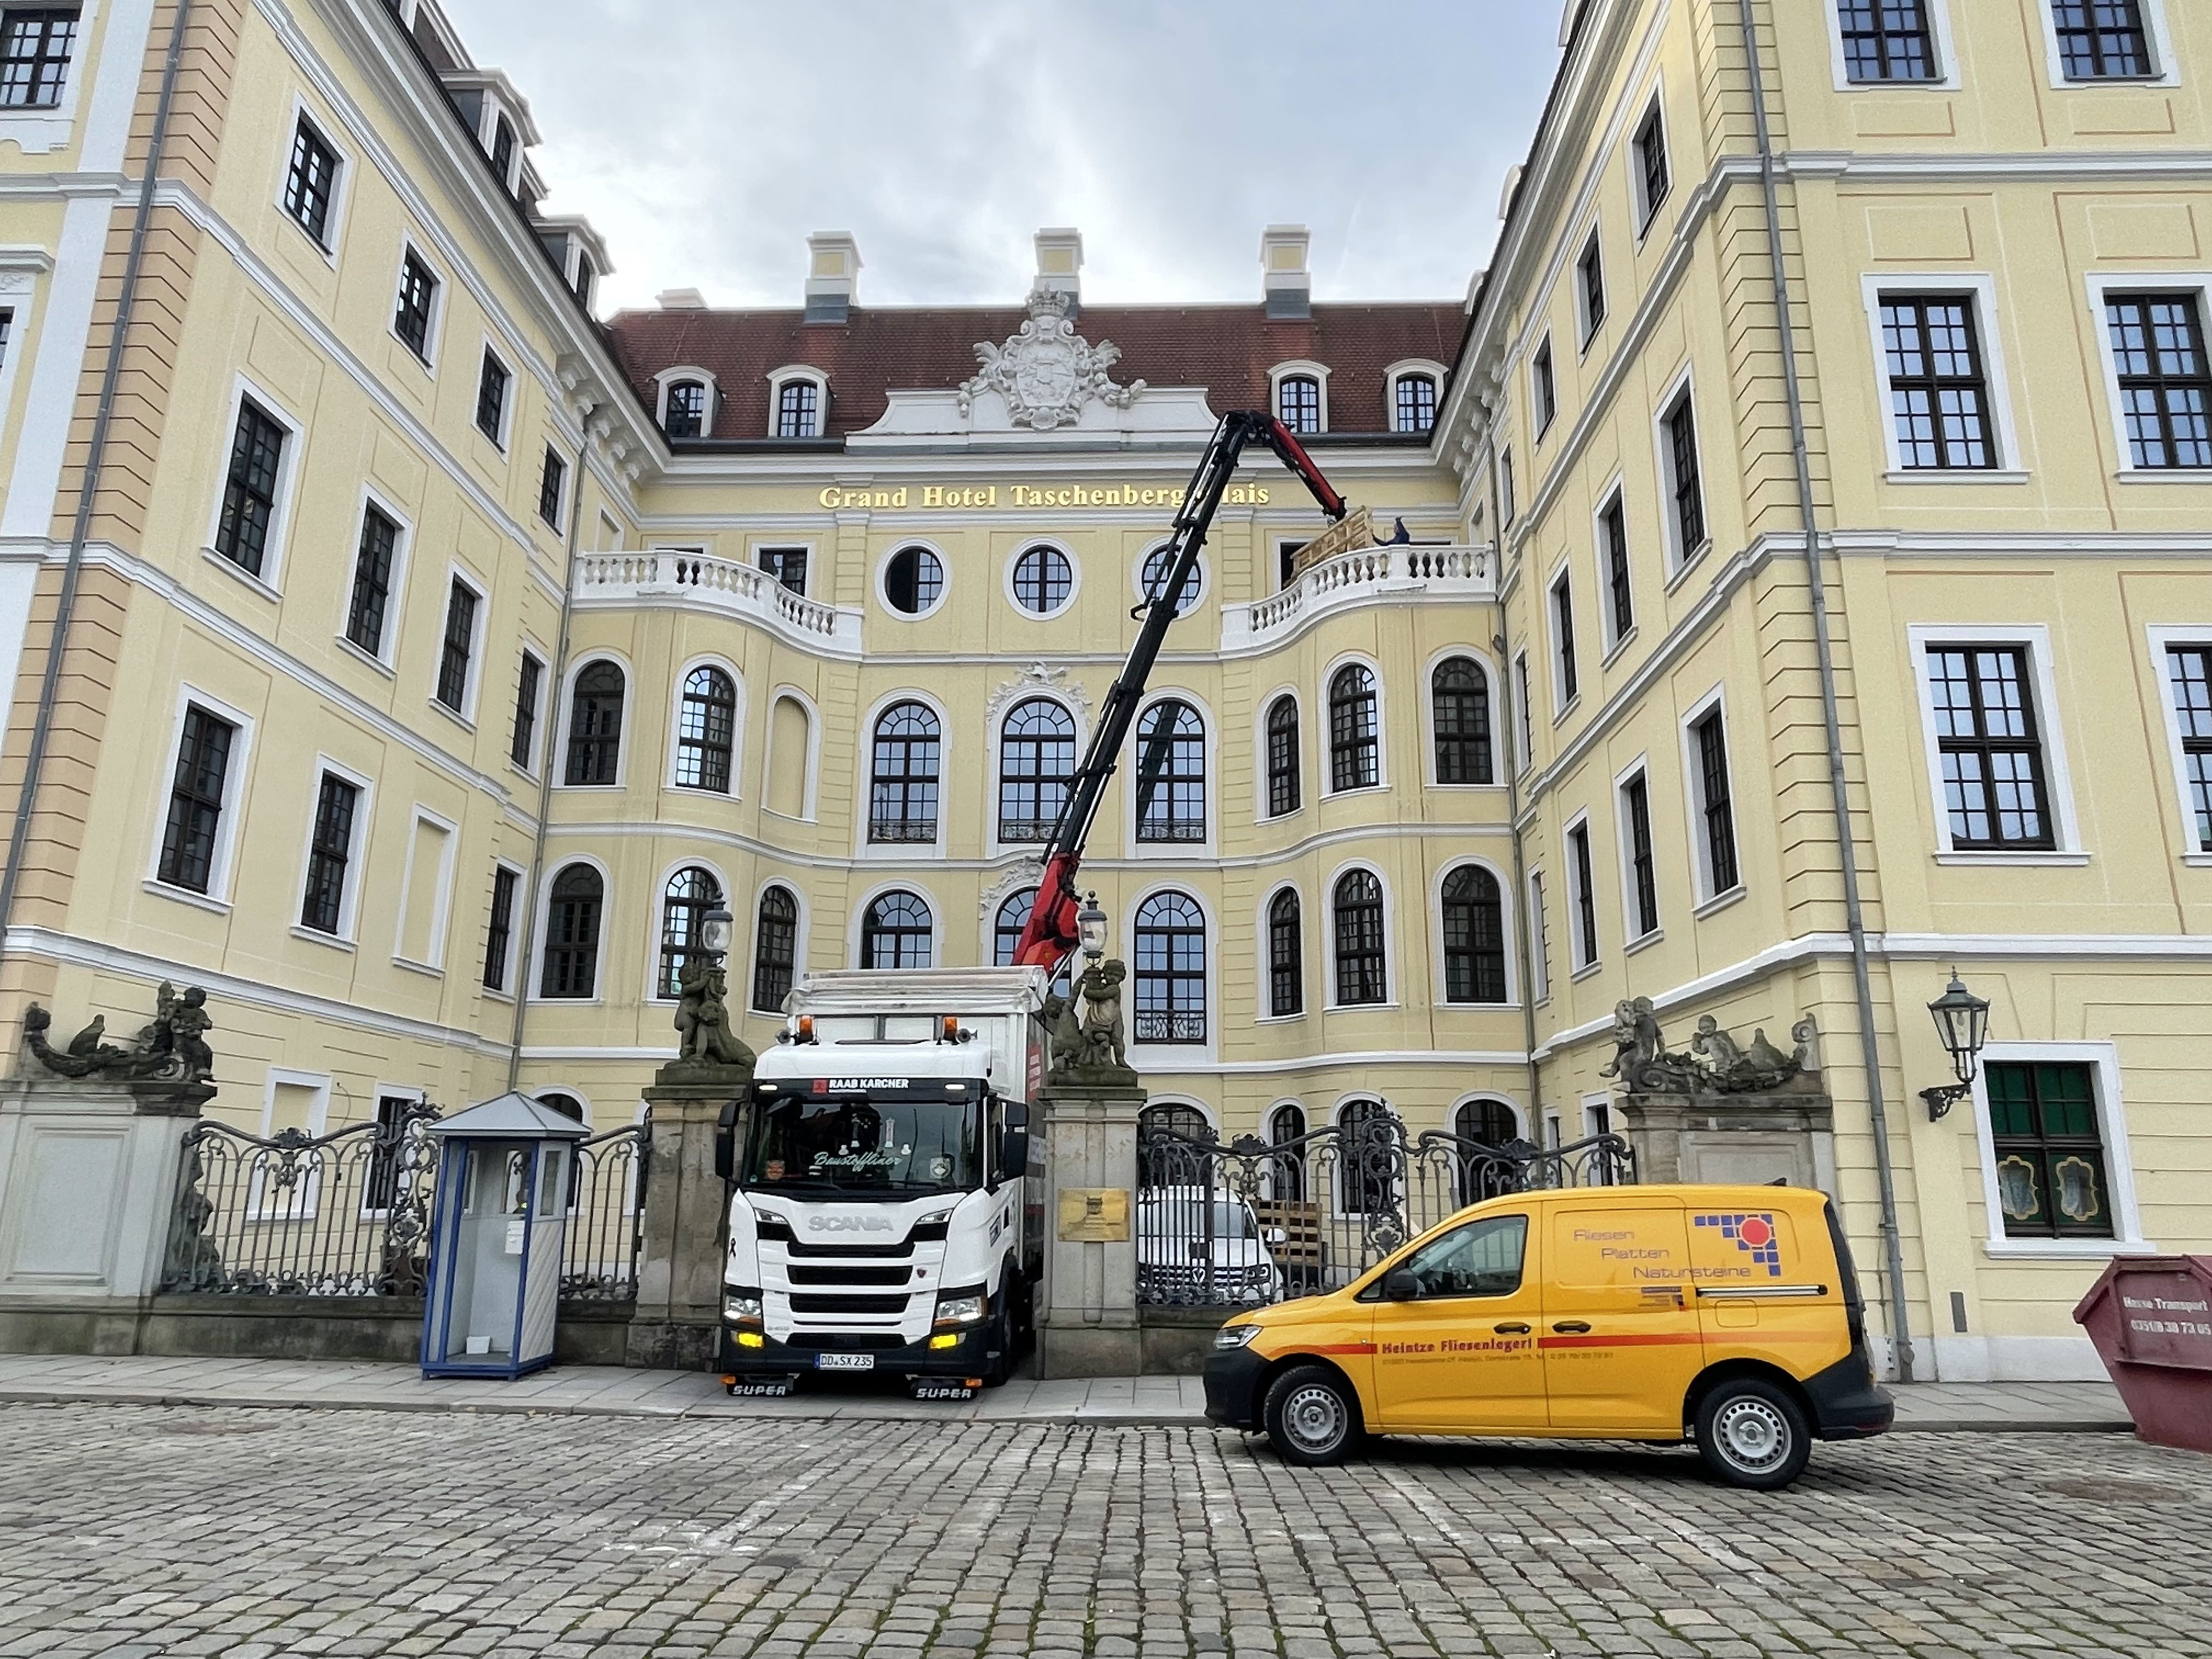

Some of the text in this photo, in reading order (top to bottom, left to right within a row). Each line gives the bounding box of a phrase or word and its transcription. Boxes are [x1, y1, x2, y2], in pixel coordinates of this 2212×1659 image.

[820, 483, 1269, 508] Grand Hotel Taschenberglais
[829, 1079, 910, 1088] RAAB KARCHER
[809, 1216, 894, 1232] SCANIA
[1573, 1229, 1635, 1241] Fliesen
[1601, 1248, 1670, 1260] Platten
[1633, 1266, 1751, 1279] Natursteine
[1382, 1342, 1435, 1354] Heintze
[821, 1355, 872, 1366] DD SX 235
[732, 1385, 786, 1396] SUPER
[916, 1388, 971, 1398] SUPER
